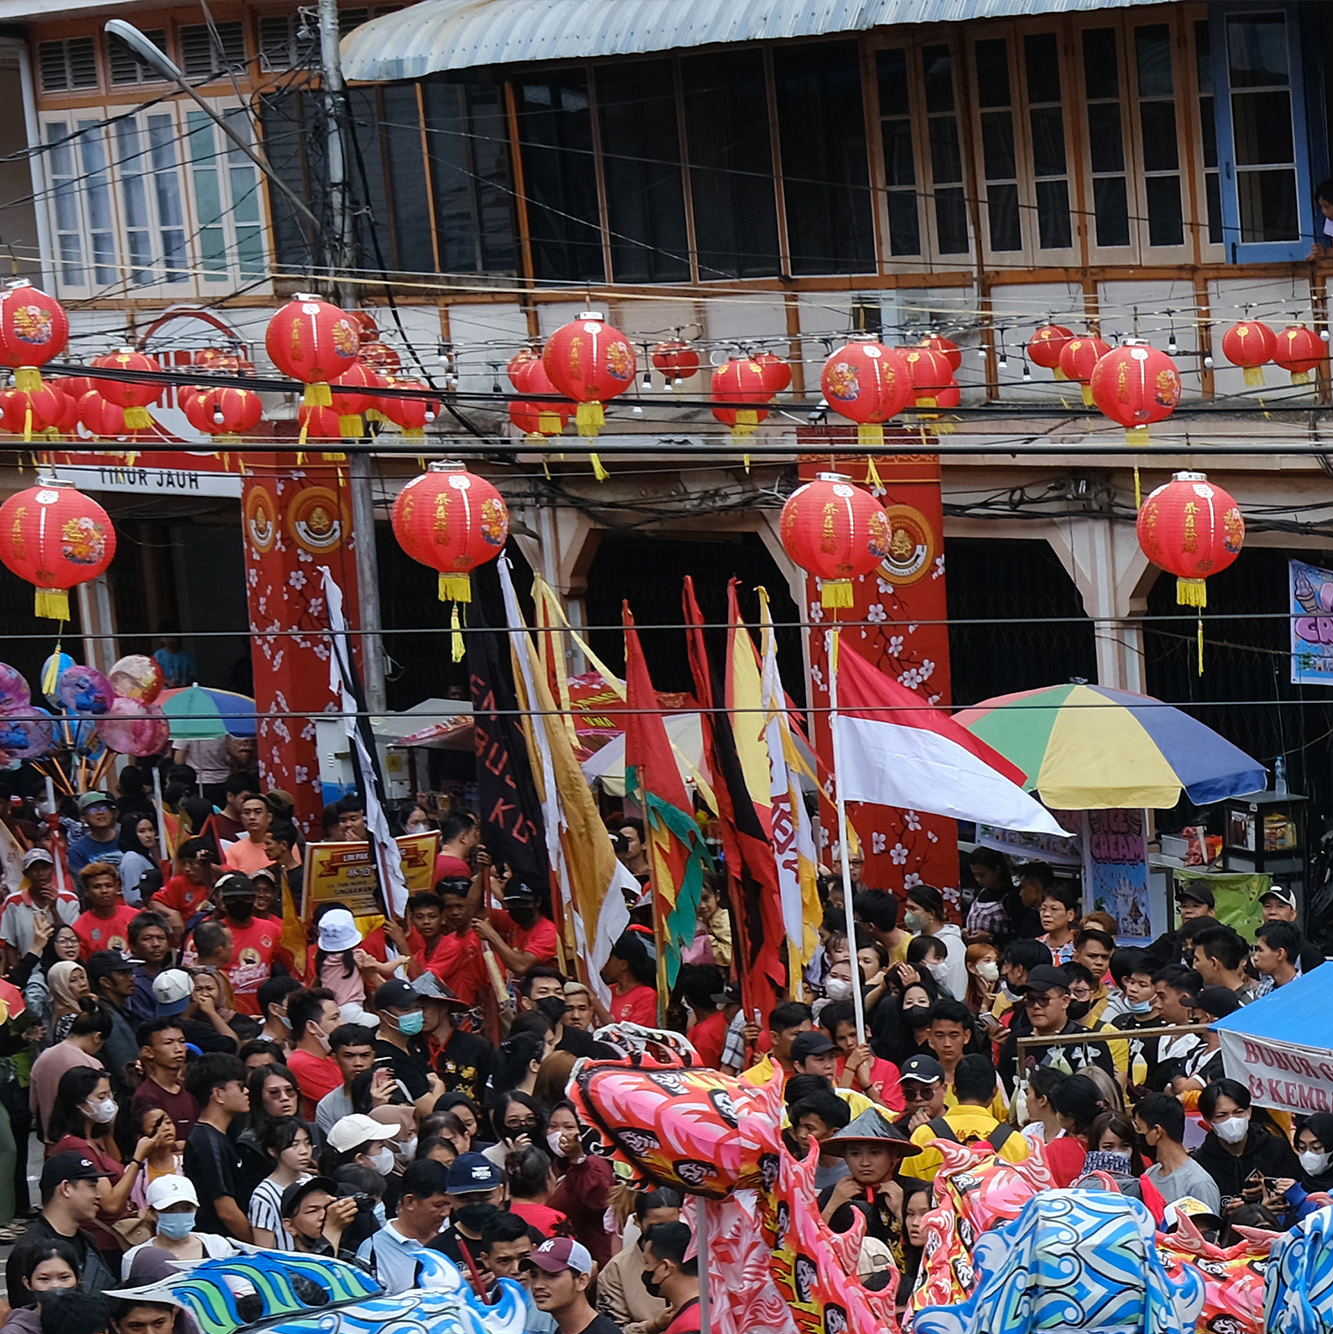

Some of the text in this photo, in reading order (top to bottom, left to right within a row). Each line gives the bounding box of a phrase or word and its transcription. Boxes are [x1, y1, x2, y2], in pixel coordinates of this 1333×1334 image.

[99, 468, 200, 490] TIMUR JAUH
[1243, 1039, 1321, 1080] BUBUR
